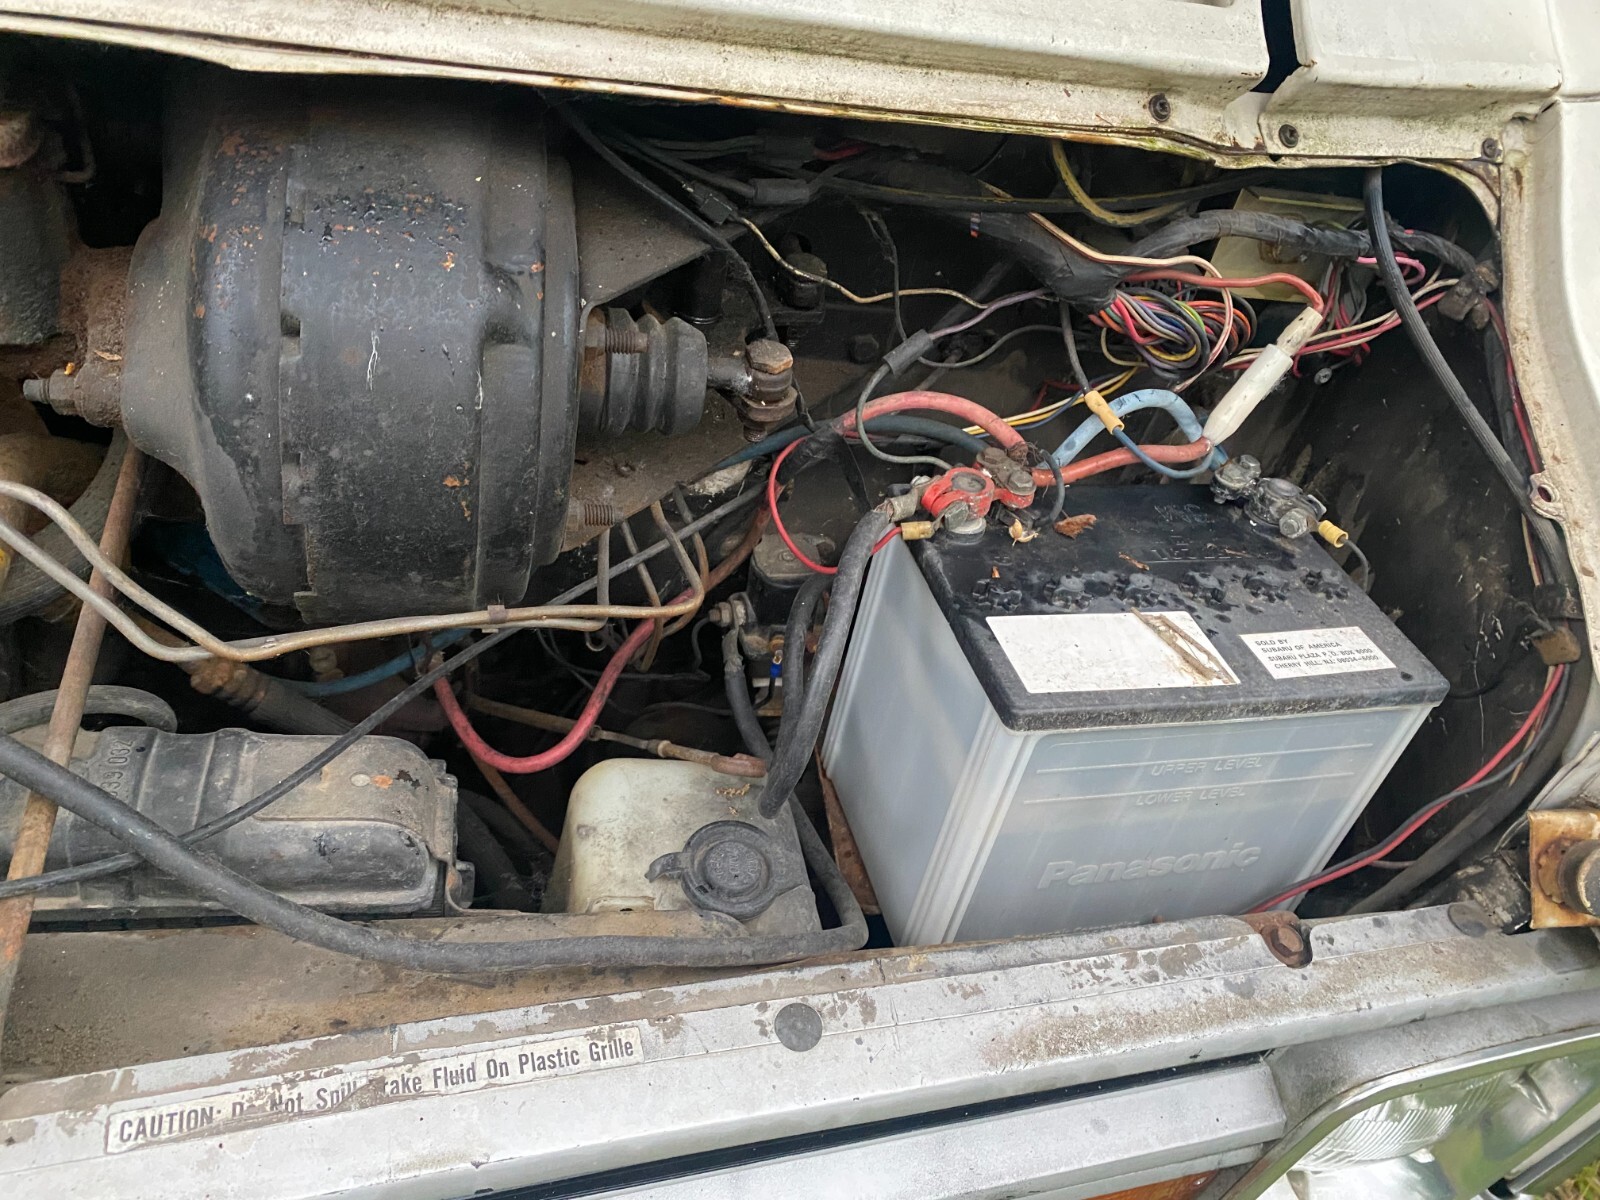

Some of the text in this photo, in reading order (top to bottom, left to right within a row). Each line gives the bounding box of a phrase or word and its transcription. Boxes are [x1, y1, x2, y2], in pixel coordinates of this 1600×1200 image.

[1308, 641, 1342, 650] AMERICA
[1268, 654, 1297, 662] SUBARU
[1298, 652, 1322, 660] PLAZA
[1151, 756, 1264, 776] UPPER LEVEL
[1136, 786, 1246, 806] LOWER LEVEL
[1036, 842, 1261, 889] Panasonic
[380, 1073, 423, 1097] rake
[432, 1061, 477, 1088] Fluid
[486, 1058, 510, 1079] On
[518, 1046, 580, 1075] Plastic
[589, 1037, 634, 1063] Grille
